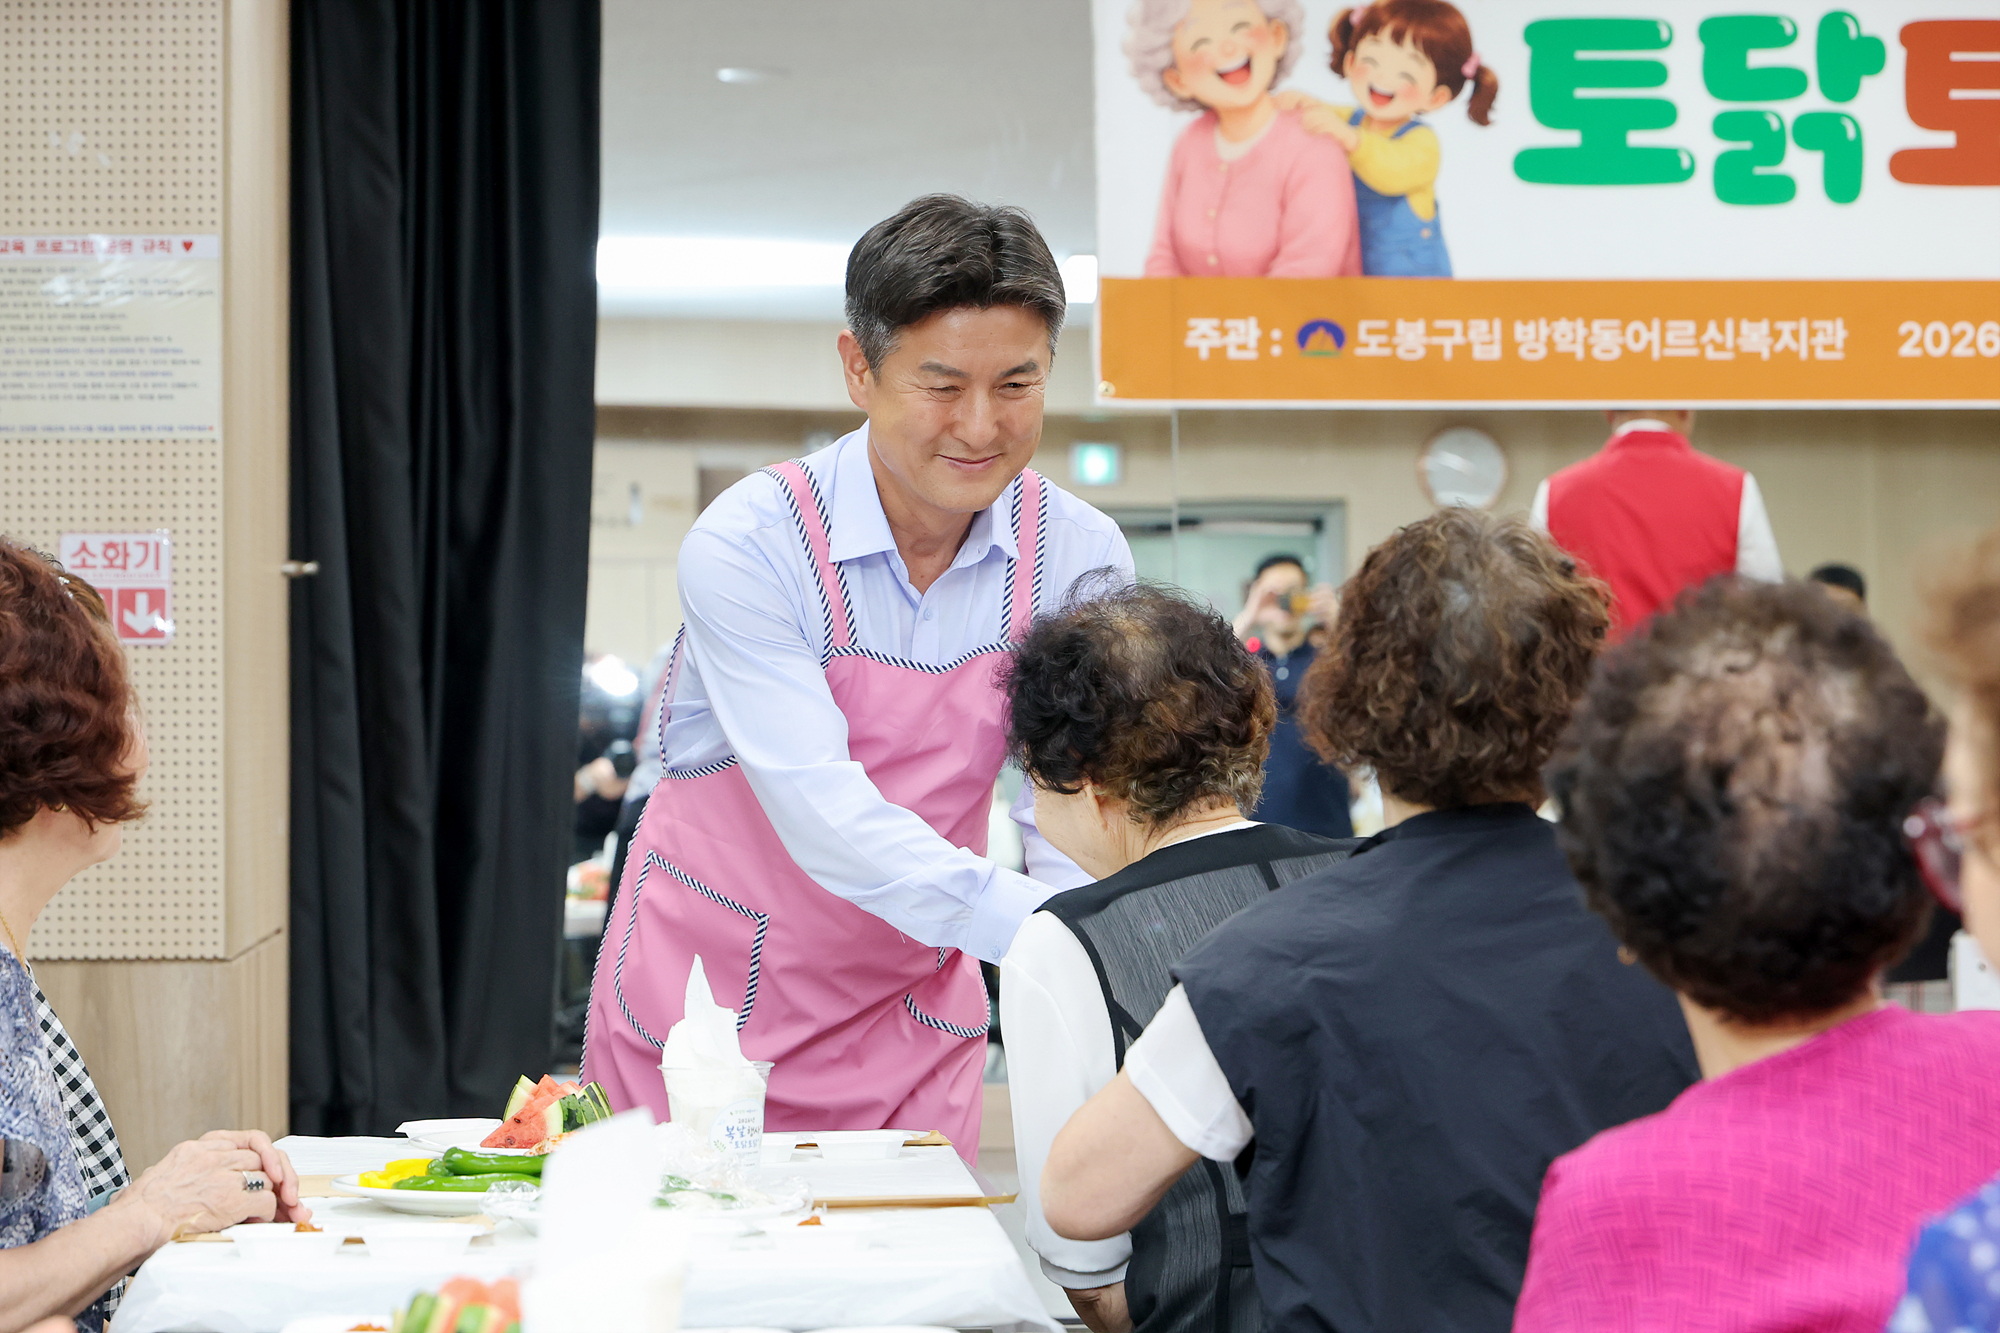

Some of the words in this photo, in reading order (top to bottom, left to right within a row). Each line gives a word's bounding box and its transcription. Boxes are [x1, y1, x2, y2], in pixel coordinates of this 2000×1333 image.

[1184, 316, 1262, 361] 주관
[1353, 317, 1502, 361] 도봉구립
[1513, 317, 1849, 361] 방학동어르신복지관
[1898, 320, 2000, 358] 2026
[70, 540, 160, 571] 소화기
[725, 1125, 746, 1140] 복날
[747, 1125, 760, 1137] 행사
